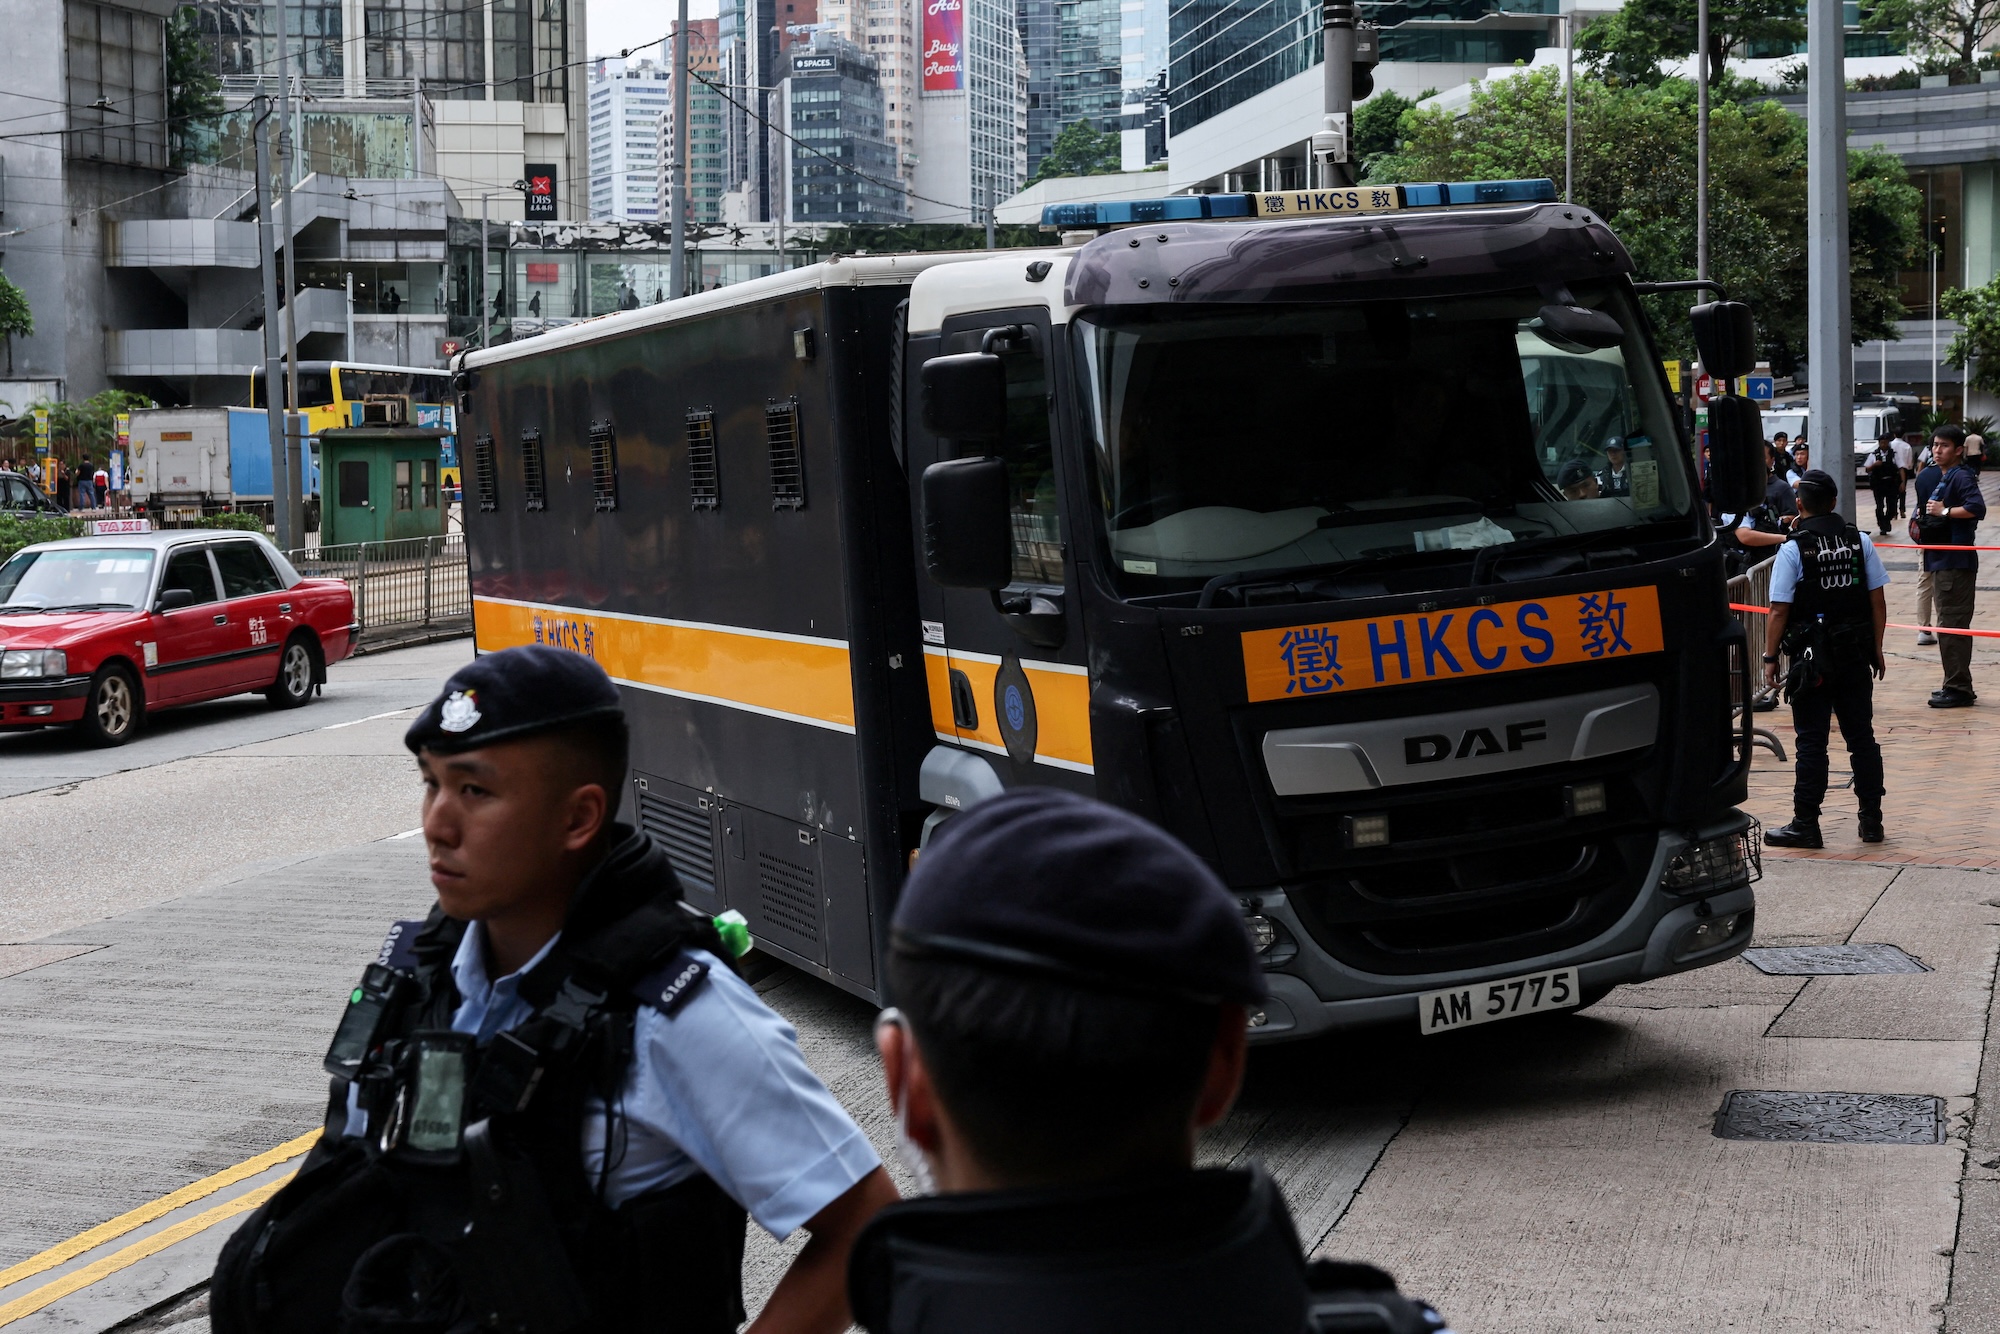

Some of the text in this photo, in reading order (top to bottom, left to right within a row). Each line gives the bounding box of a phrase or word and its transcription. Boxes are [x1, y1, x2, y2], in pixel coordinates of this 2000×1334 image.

[928, 0, 961, 16] Ads
[924, 39, 959, 59] Busy
[924, 60, 963, 77] Reach
[531, 195, 552, 204] DBS
[1296, 191, 1360, 211] HKCS
[97, 520, 142, 532] TAXI
[249, 615, 266, 631] 的士
[250, 629, 268, 646] TAXI
[548, 619, 580, 654] HKCS
[1278, 626, 1345, 694] 懲
[1367, 603, 1555, 683] HKCS
[1404, 719, 1547, 765] DAF
[661, 963, 701, 1003] 61690
[1430, 972, 1570, 1028] AM 5775
